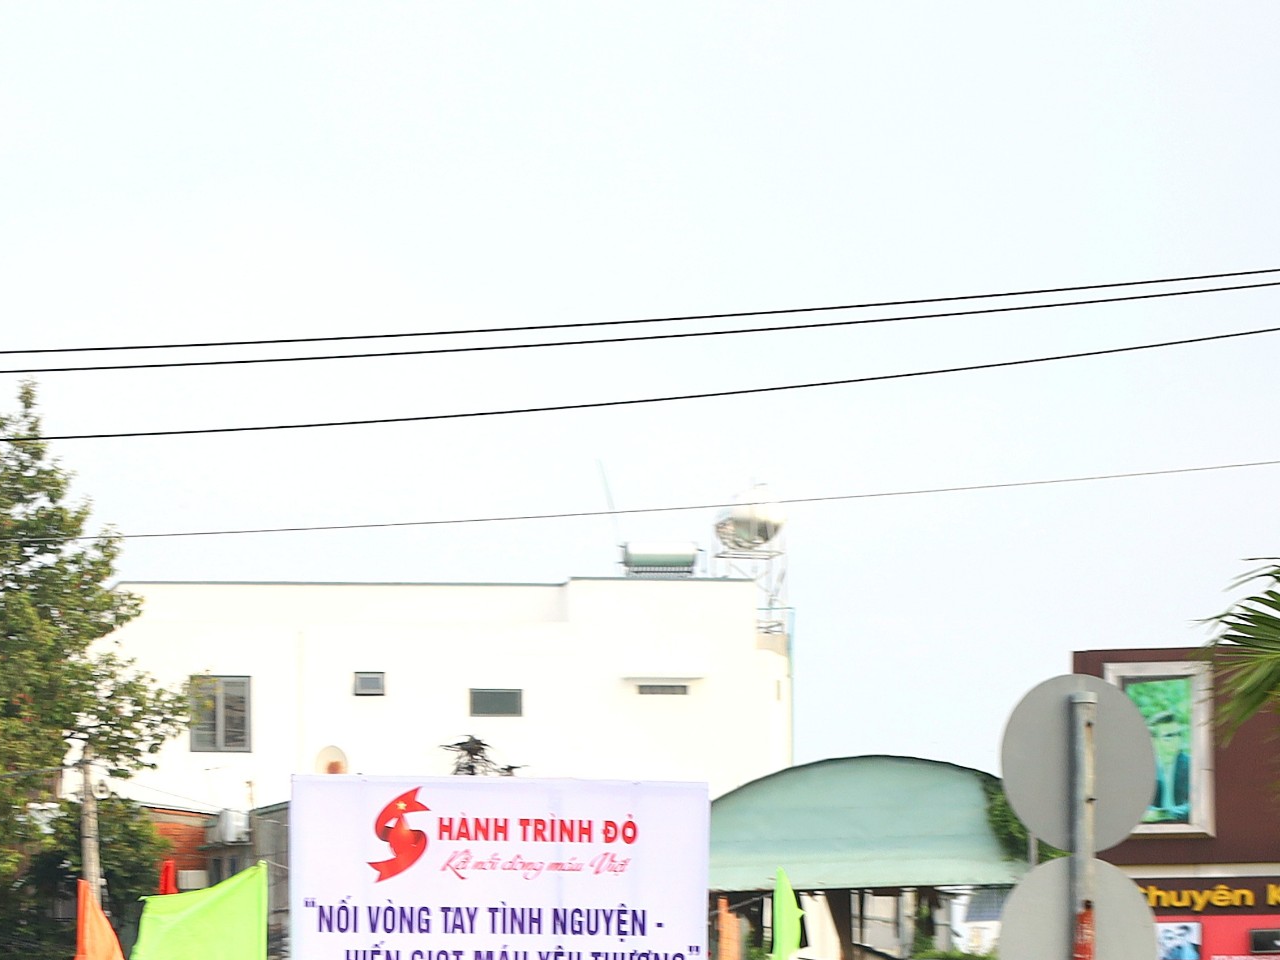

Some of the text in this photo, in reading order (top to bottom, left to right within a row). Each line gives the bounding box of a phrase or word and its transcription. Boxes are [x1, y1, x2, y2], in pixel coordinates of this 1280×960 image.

[437, 812, 639, 845] HÀNH TRÌNH ĐỎ
[1138, 884, 1255, 912] huyên
[368, 899, 431, 934] VÒNG
[441, 906, 478, 934] TAY
[488, 901, 542, 935] TÌNH
[552, 903, 647, 942] NGUYỆN
